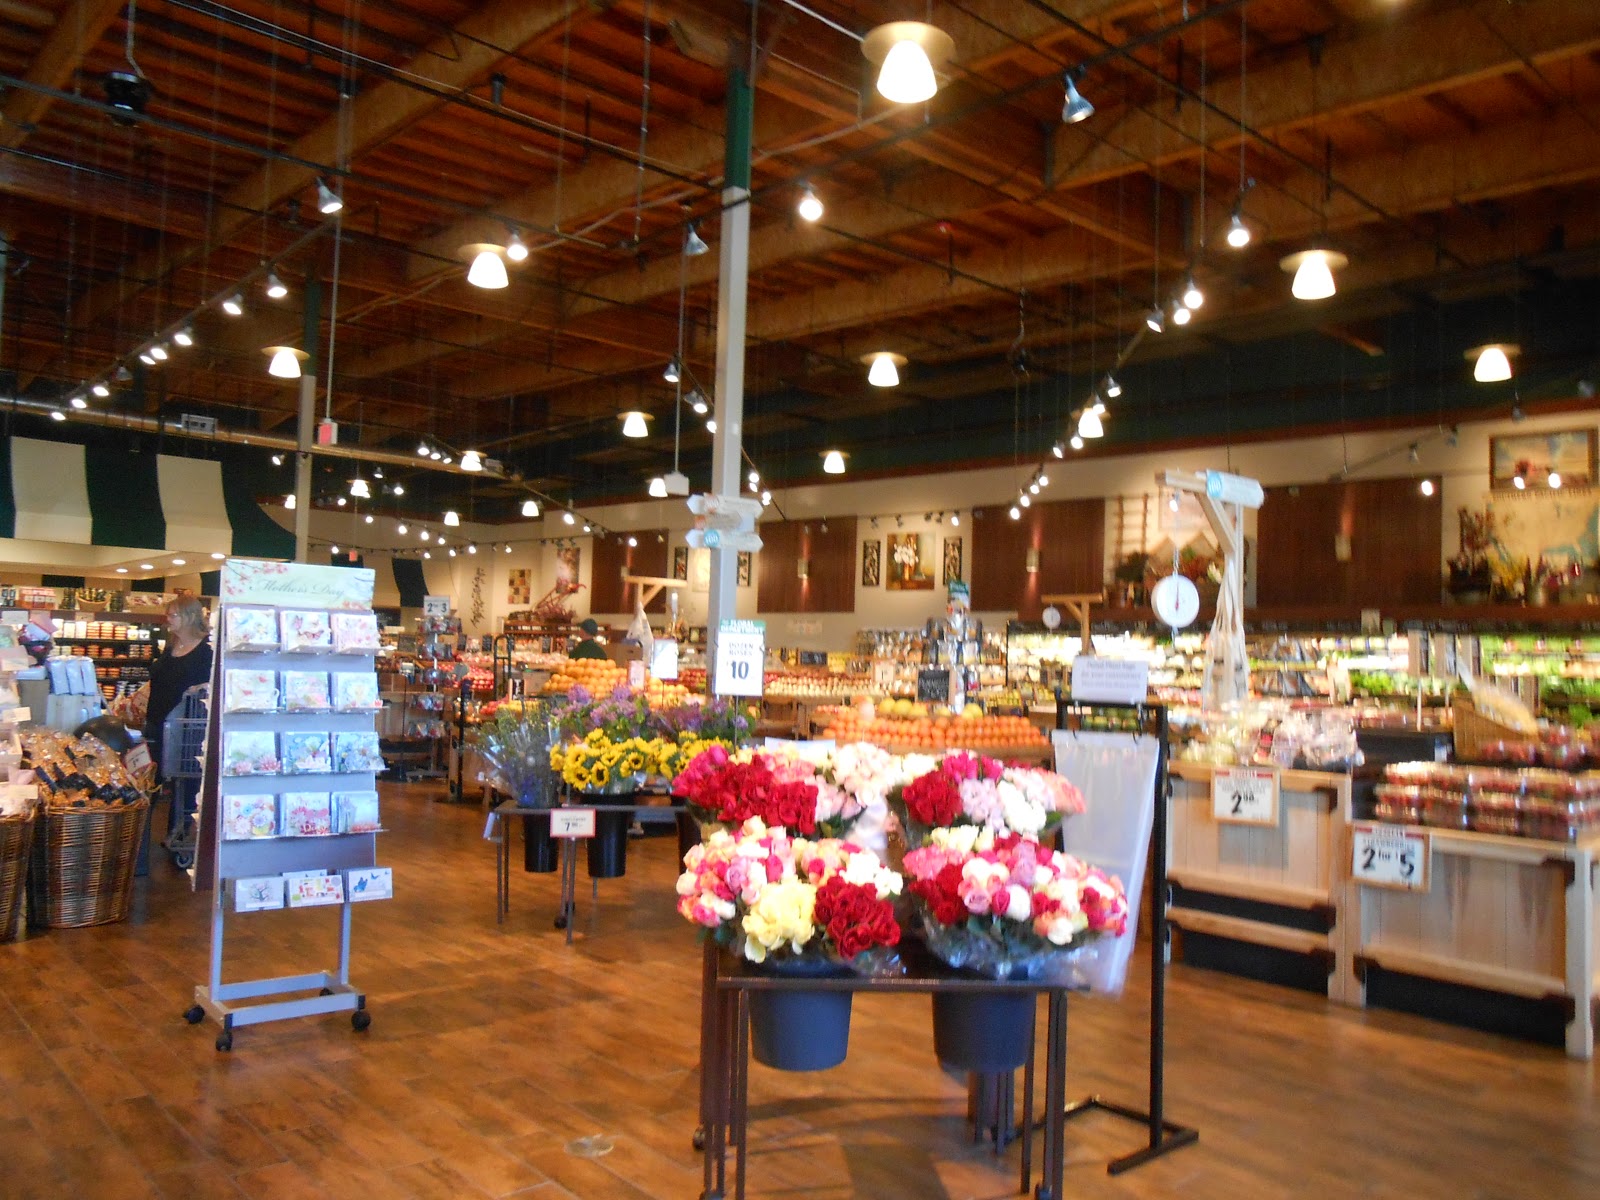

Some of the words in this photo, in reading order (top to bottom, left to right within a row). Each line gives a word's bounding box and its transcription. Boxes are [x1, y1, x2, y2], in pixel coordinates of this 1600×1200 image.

[312, 579, 345, 602] Day
[720, 625, 765, 634] DEPARTMENT
[1362, 848, 1376, 870] 2
